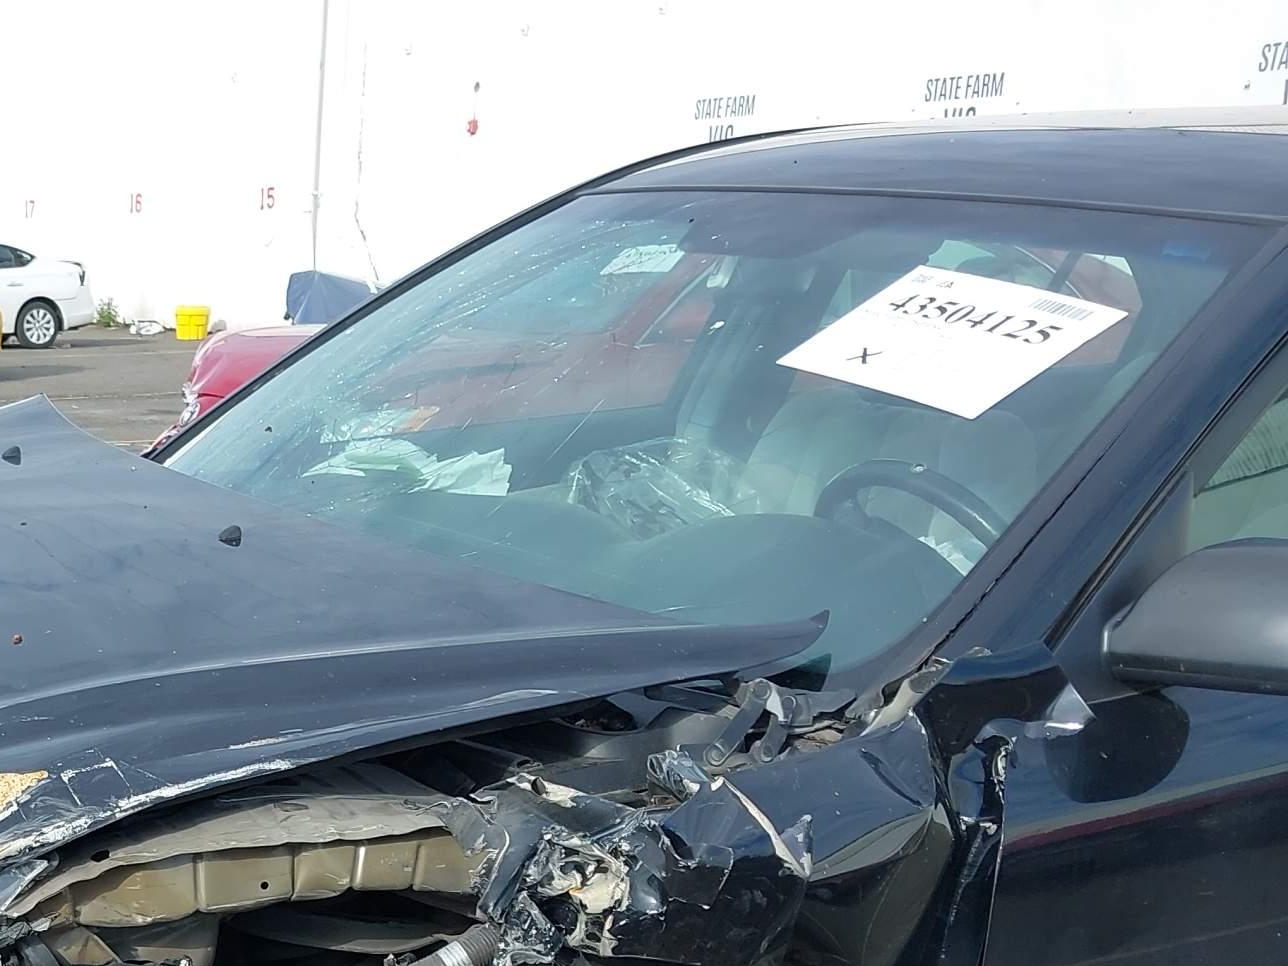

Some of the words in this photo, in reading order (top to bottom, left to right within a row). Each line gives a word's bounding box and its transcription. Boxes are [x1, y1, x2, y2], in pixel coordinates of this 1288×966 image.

[924, 76, 963, 102] STATE
[964, 72, 1005, 99] FARM
[694, 97, 724, 120] STATE
[725, 94, 756, 118] FARM
[24, 200, 35, 219] 17
[129, 193, 142, 214] 16
[259, 187, 276, 211] 15
[889, 294, 1064, 345] 43504125
